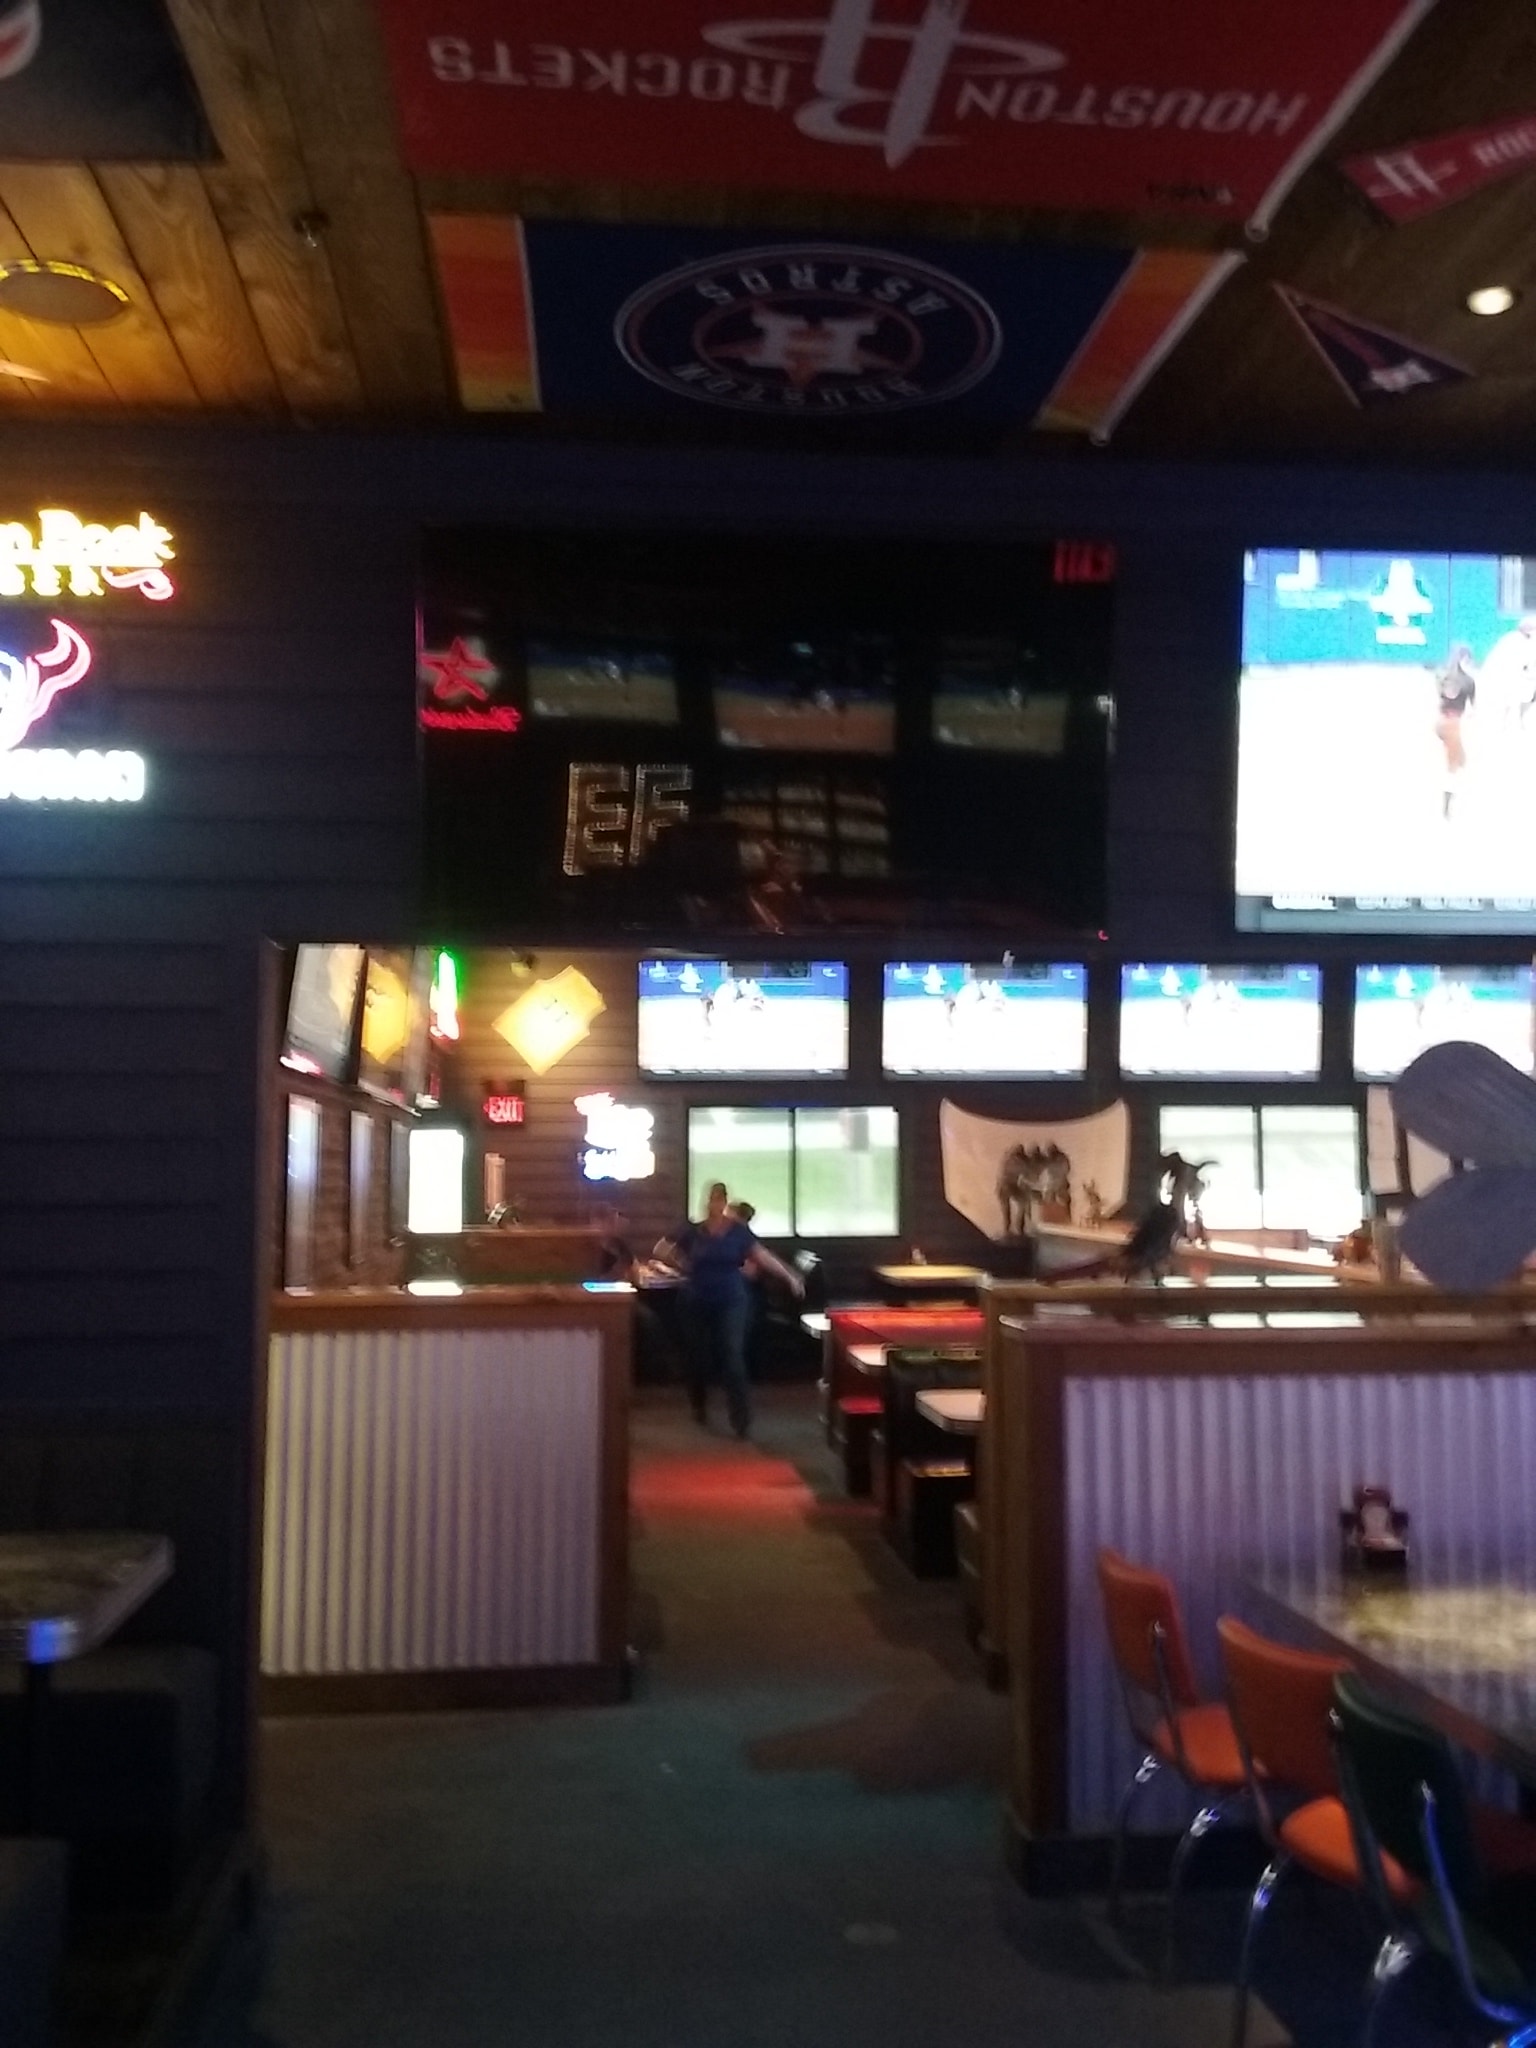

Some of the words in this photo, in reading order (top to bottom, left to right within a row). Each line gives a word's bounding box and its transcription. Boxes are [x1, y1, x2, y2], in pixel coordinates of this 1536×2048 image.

[426, 35, 793, 110] ROCKETS
[954, 79, 1311, 136] HOUSTON
[694, 262, 950, 316] ASTROS
[670, 363, 923, 407] HOUSTON
[489, 1097, 524, 1123] EXIT
